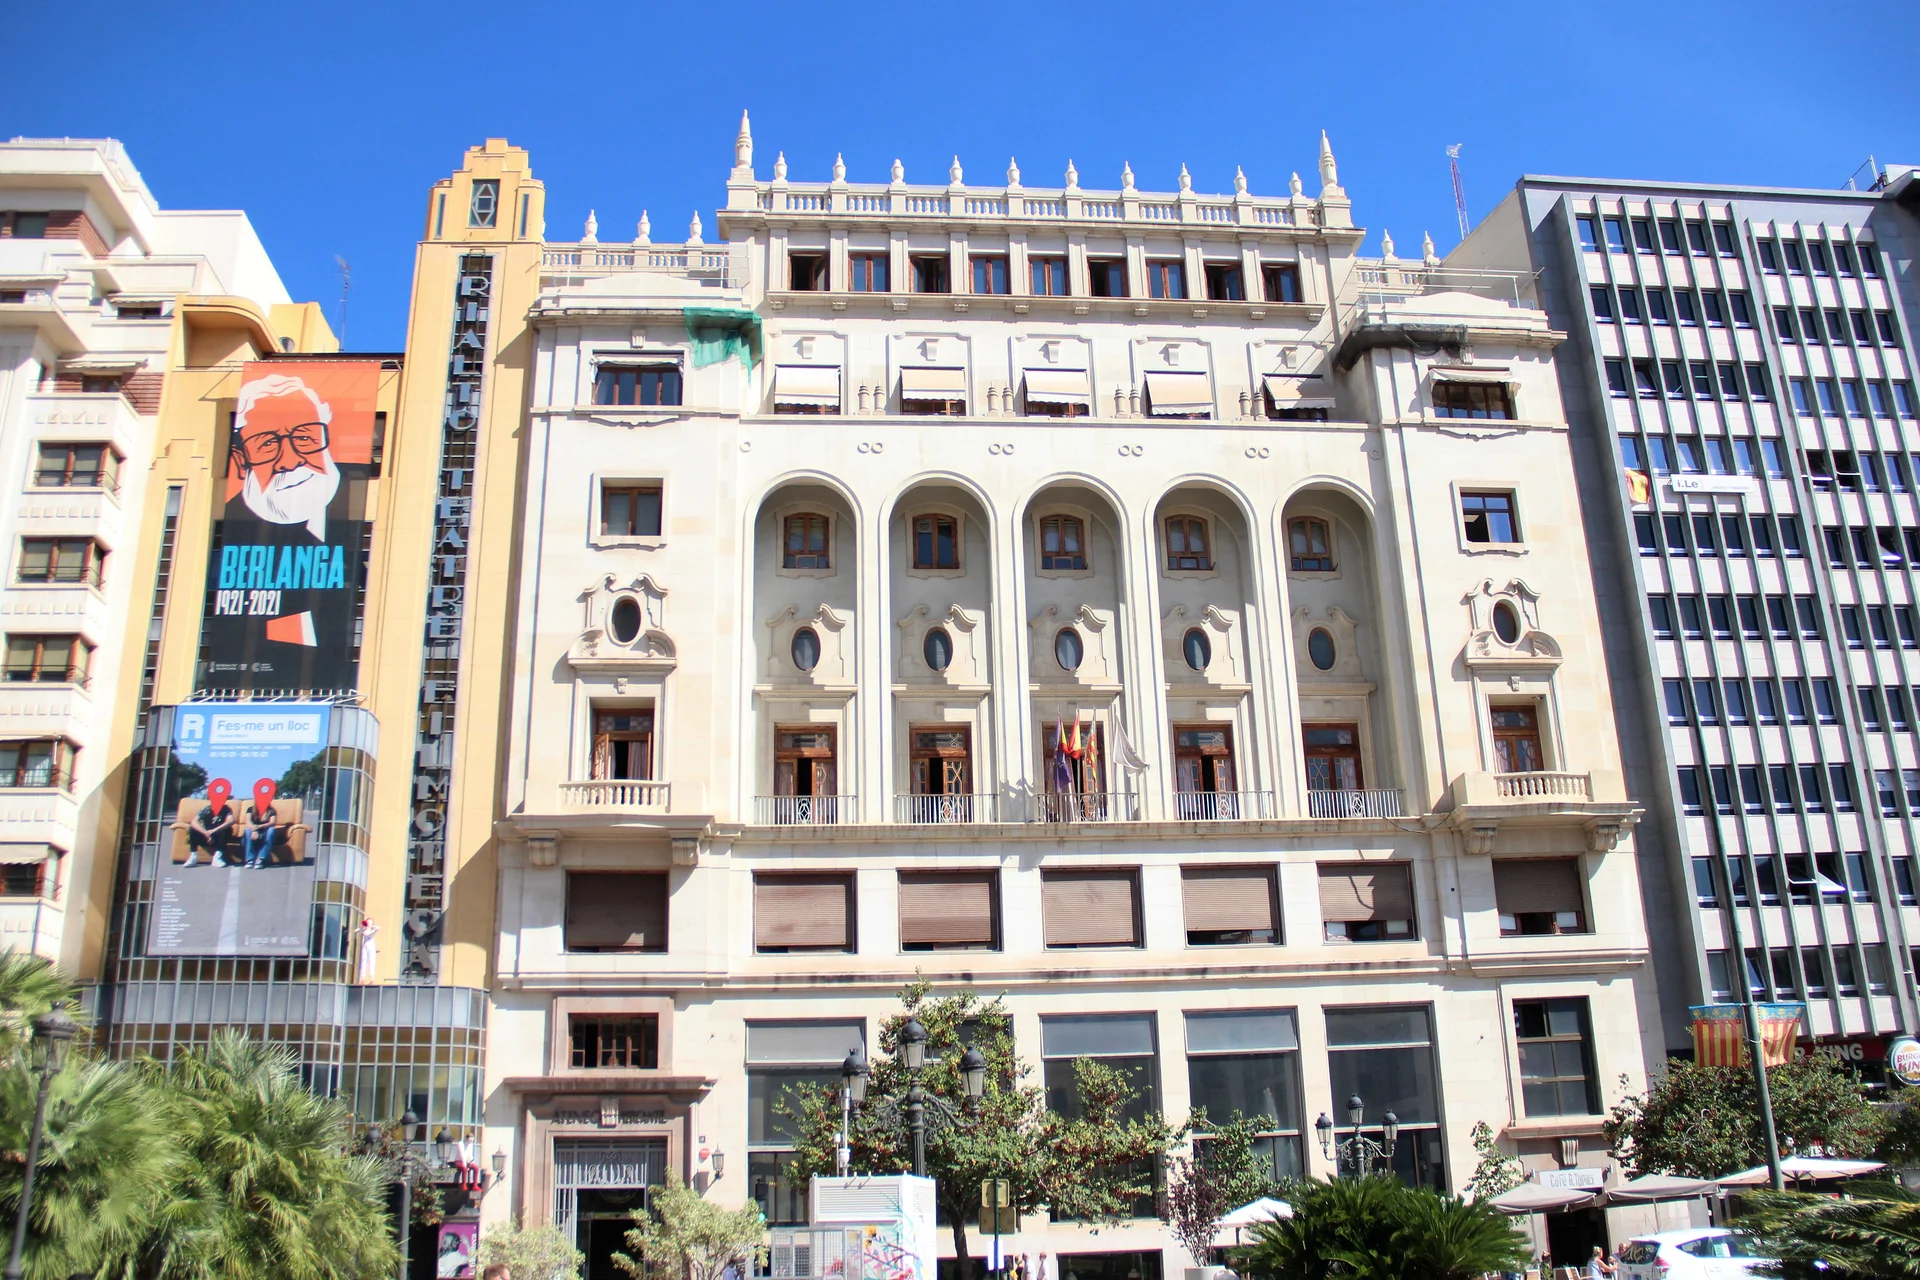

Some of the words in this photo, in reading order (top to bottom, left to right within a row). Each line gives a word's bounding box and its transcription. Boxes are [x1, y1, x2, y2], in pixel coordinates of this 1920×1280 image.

[430, 468, 473, 638] TEATRE
[219, 545, 345, 589] BERLANGA
[217, 720, 264, 731] Fes-me
[268, 722, 284, 731] un
[288, 720, 310, 731] lloc
[405, 680, 456, 977] FILMOTECA
[1897, 1052, 1920, 1063] BURG
[1898, 1060, 1920, 1071] KIN
